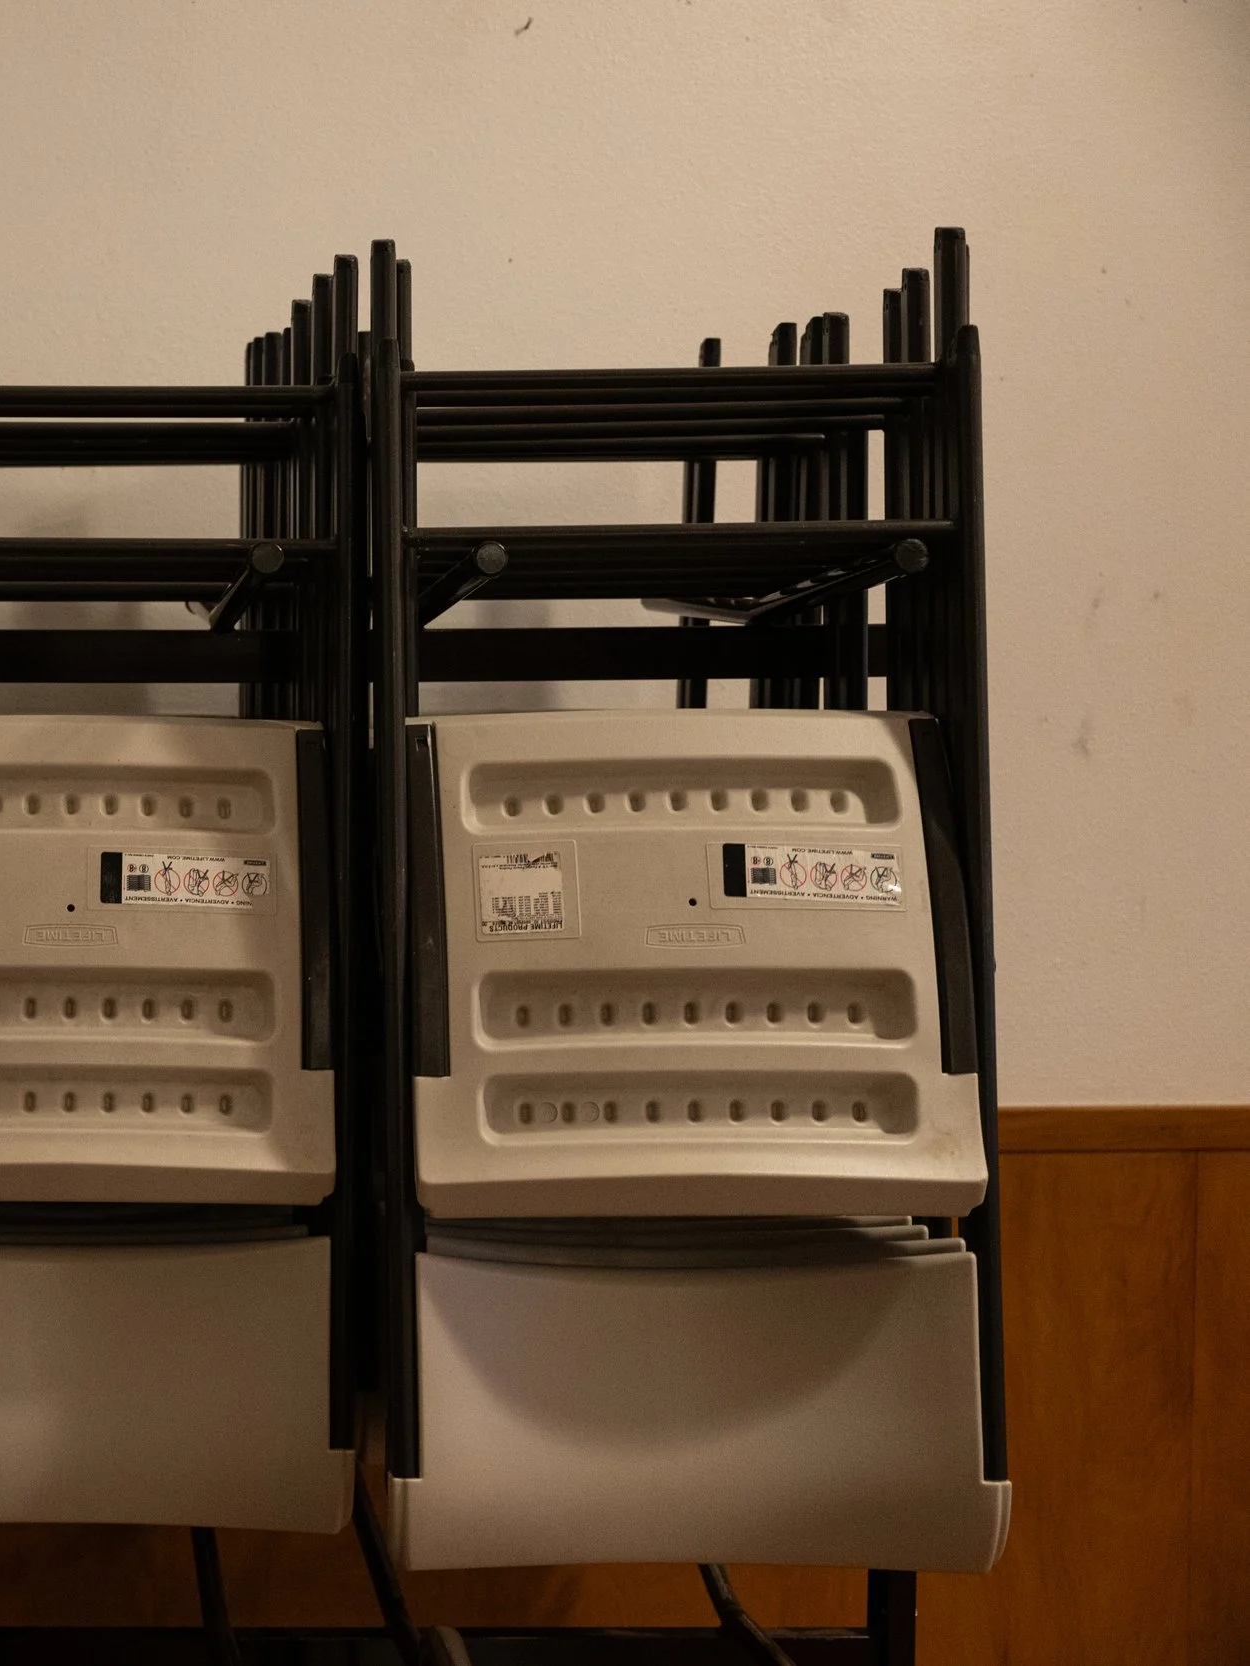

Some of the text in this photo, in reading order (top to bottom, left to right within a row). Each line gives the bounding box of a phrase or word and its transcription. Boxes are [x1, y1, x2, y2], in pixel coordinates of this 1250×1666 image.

[791, 847, 853, 855] WWW.LIFETIME.COM
[750, 889, 806, 897] AVERTISSEMENT
[812, 892, 859, 900] ADVERTENCIA
[124, 895, 179, 903] AVERTISSEMENT
[489, 922, 563, 932] LIFETIME PRODUCTS
[35, 929, 105, 942] LIFETIME
[658, 930, 731, 943] LIFETIME
